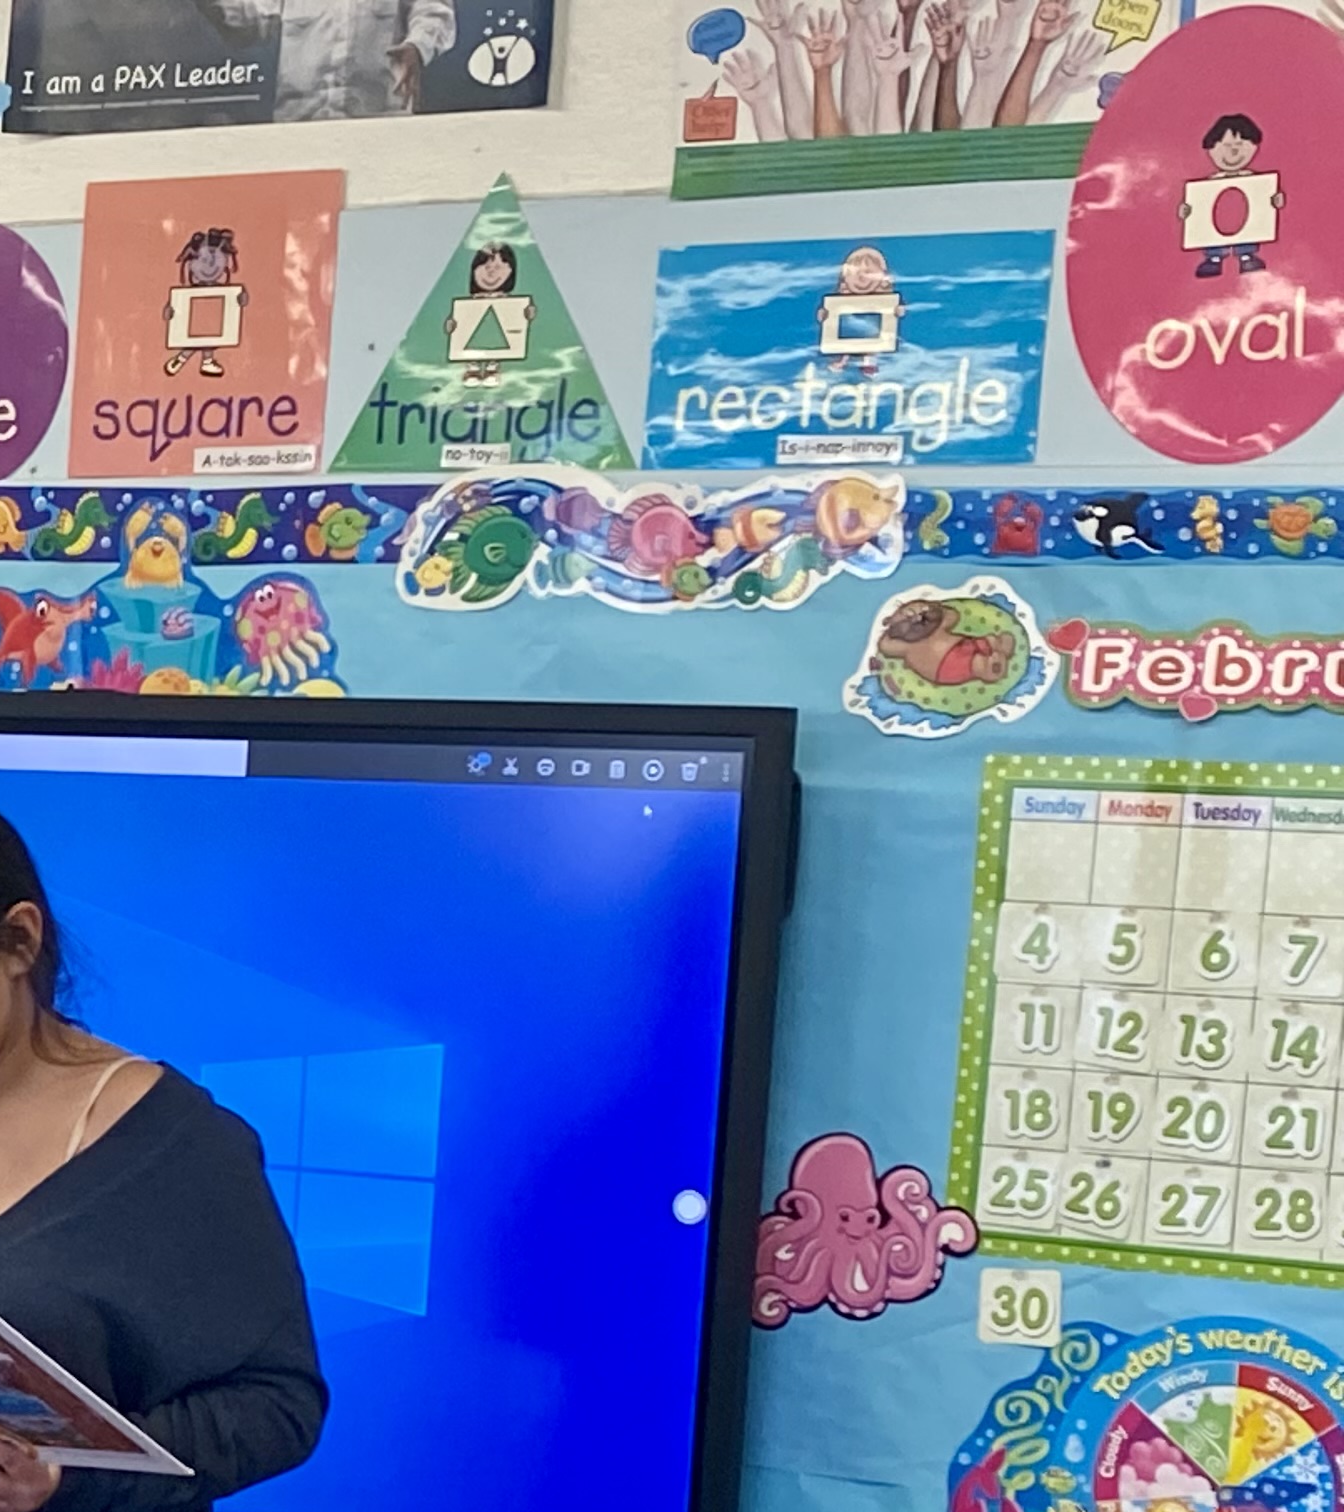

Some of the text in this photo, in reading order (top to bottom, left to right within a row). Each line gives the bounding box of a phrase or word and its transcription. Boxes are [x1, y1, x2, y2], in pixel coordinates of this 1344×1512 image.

[21, 59, 265, 96] I am a PAX Leader.
[1144, 287, 1308, 369] oval
[92, 389, 299, 464] square
[369, 378, 602, 466] triangle
[673, 357, 1008, 452] rectangle
[1024, 797, 1263, 827] Sunday Monday Tuesday
[1021, 921, 1320, 978] 4 5 6 7
[1019, 1002, 1320, 1069] 11 12 13 14
[1004, 1088, 1319, 1151] 18 19 20 21
[992, 1165, 1315, 1232] 25 26 27 28
[992, 1283, 1050, 1329] 30
[1092, 1325, 1326, 1400] Today's weather
[1158, 1368, 1209, 1393] Windy
[1265, 1377, 1314, 1411] Sunny
[1099, 1425, 1129, 1478] Cloudy
